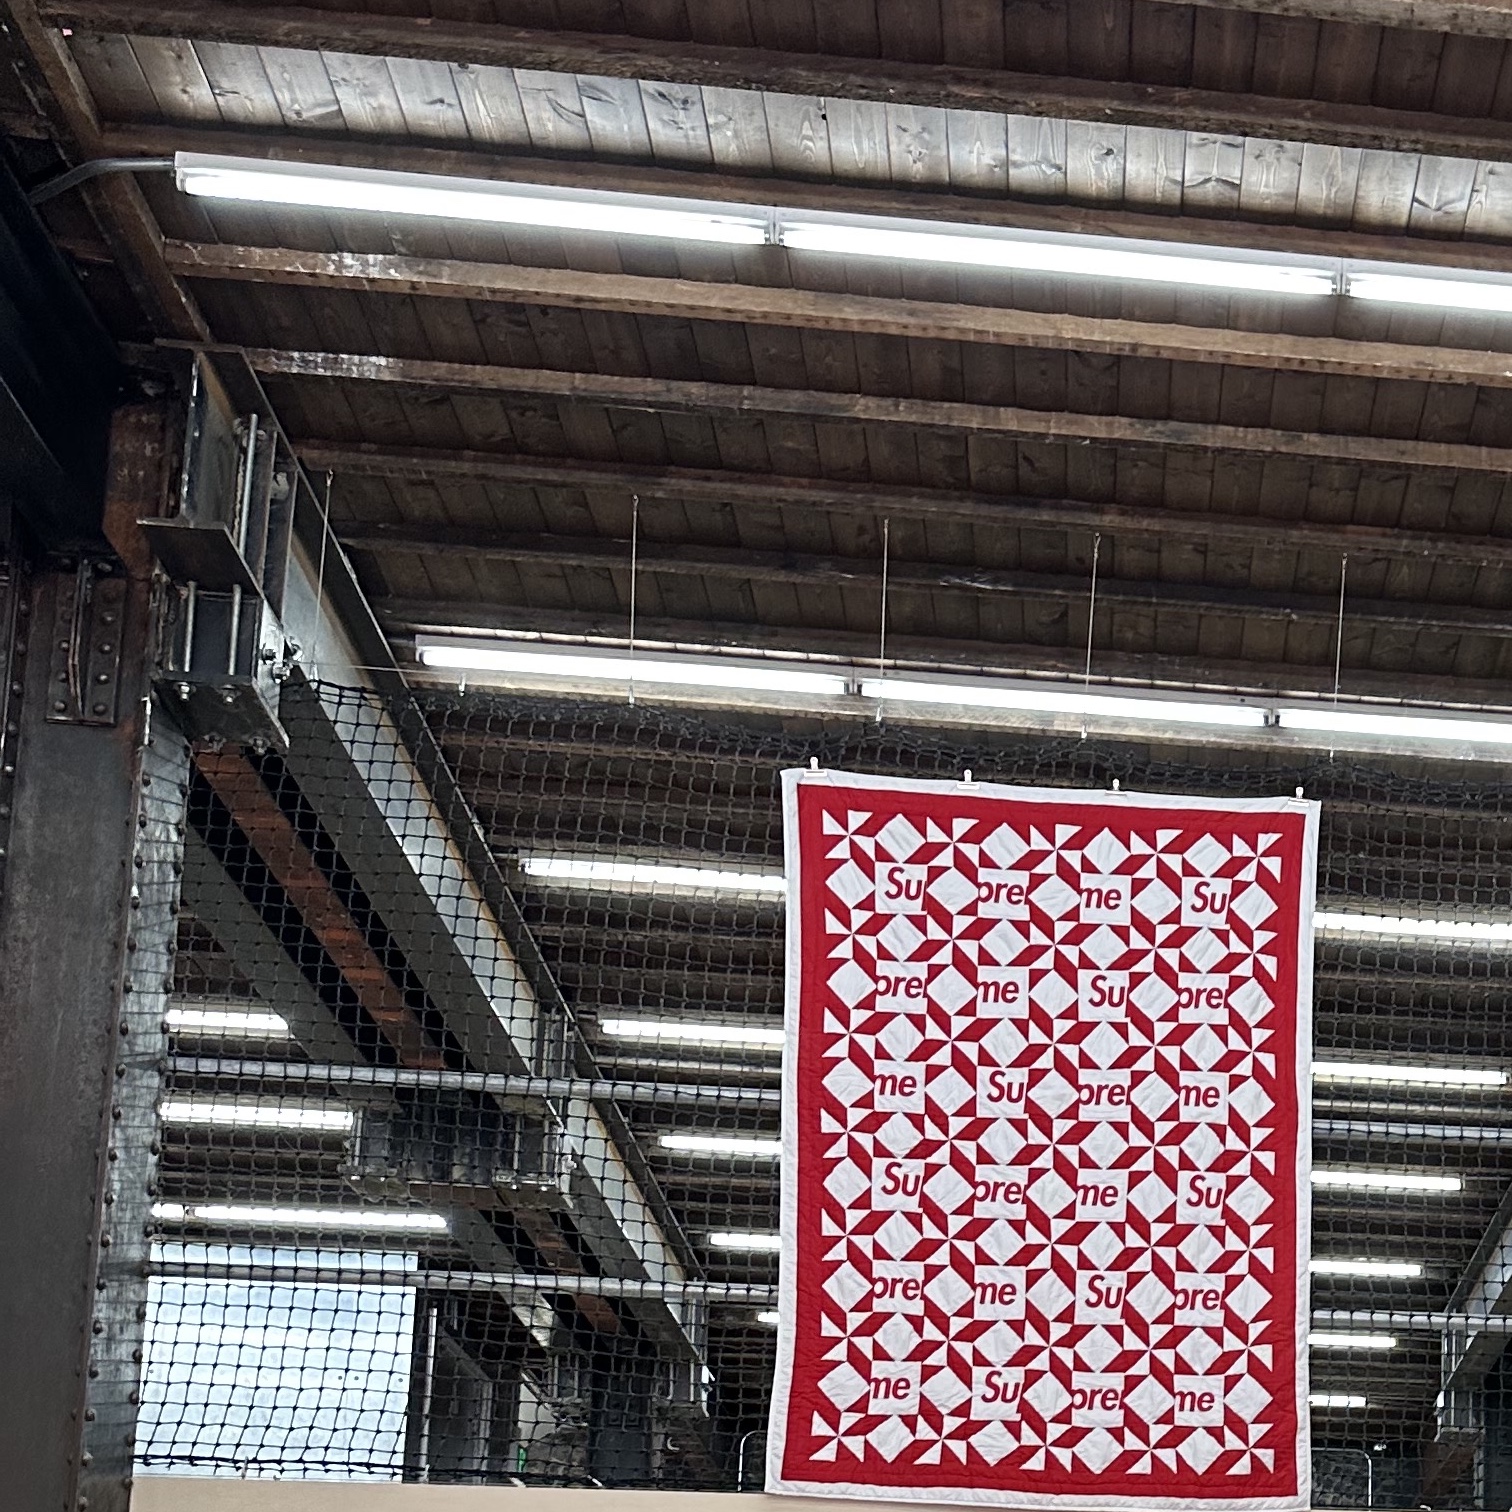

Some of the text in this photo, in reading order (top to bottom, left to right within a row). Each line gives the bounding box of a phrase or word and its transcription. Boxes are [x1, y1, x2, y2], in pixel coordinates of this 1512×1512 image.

[885, 866, 923, 901] Su
[1080, 887, 1122, 911] me
[1190, 881, 1228, 915] Su
[978, 979, 1020, 1004] me
[1088, 974, 1126, 1008] Su
[874, 1073, 917, 1098] me
[987, 1070, 1025, 1104] Su
[1180, 1084, 1221, 1109] me
[881, 1162, 921, 1198] Su
[1076, 1184, 1119, 1207] me
[1186, 1174, 1224, 1210] Su
[975, 1281, 1017, 1305] me
[1085, 1274, 1123, 1309] Su
[870, 1376, 911, 1401] me
[981, 1371, 1021, 1404] Su
[1175, 1388, 1215, 1412] me
